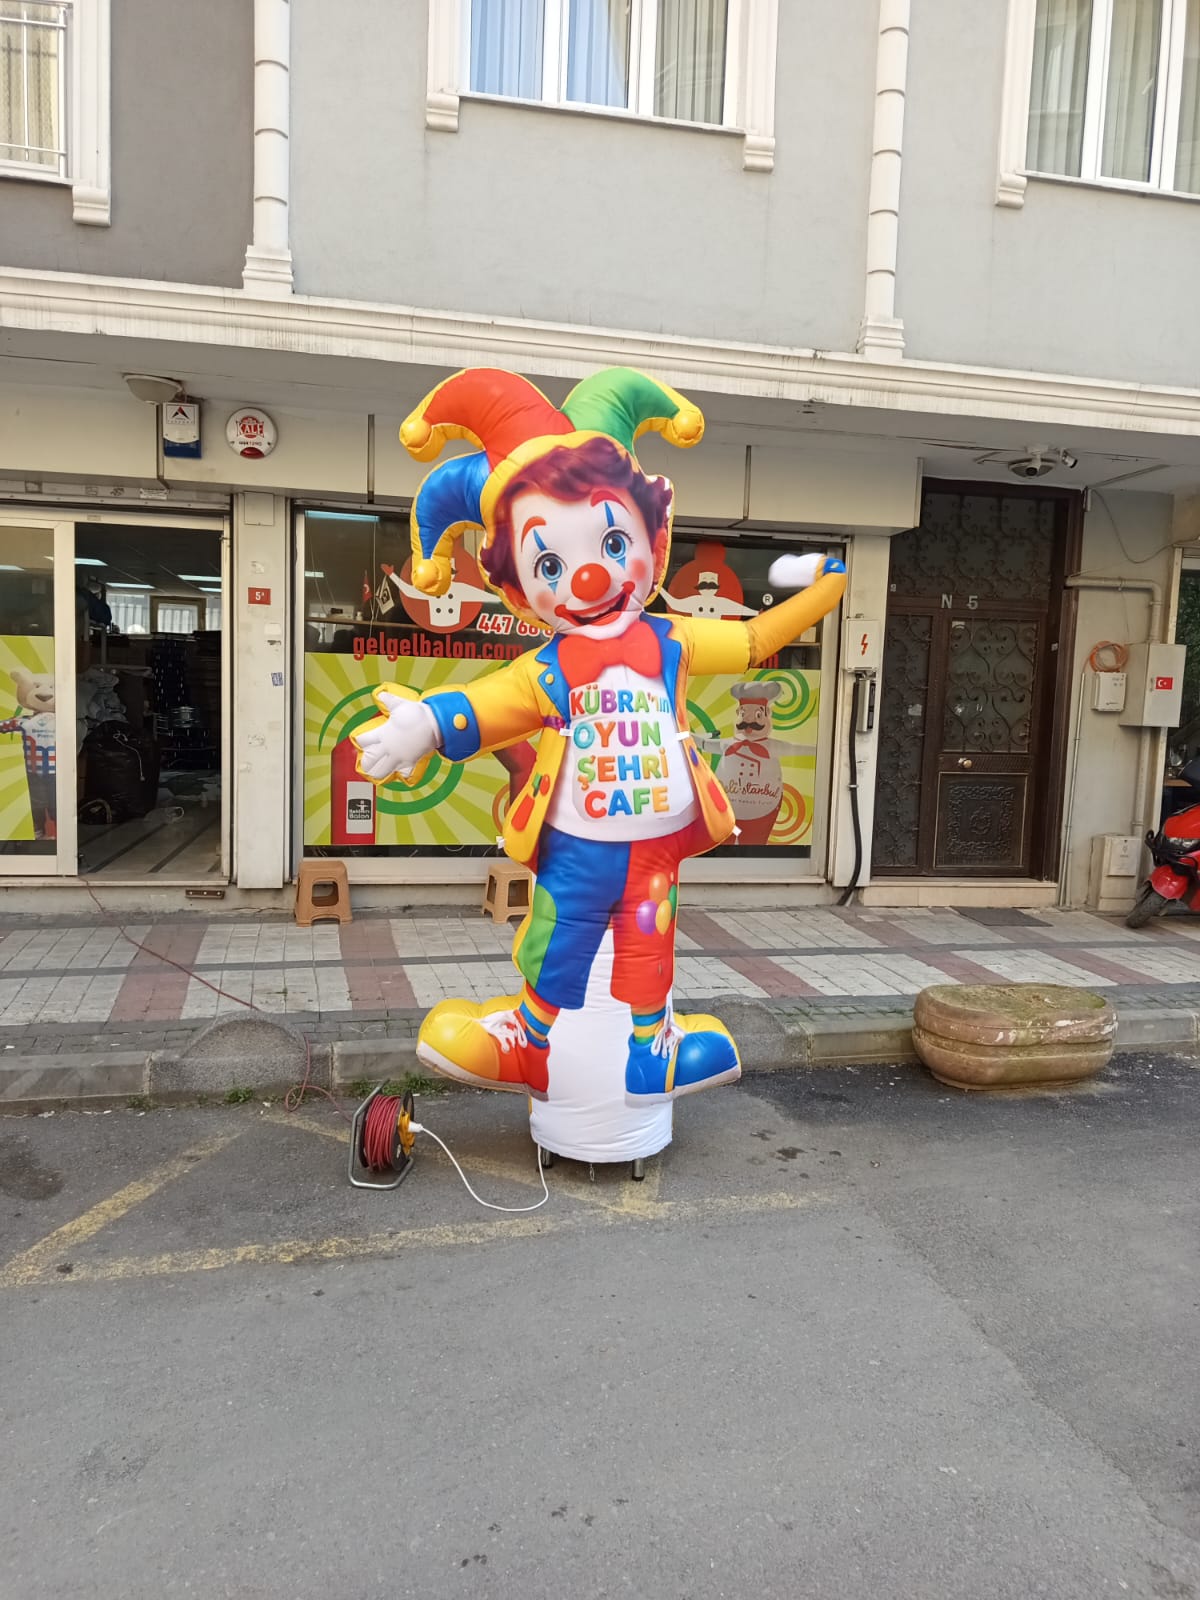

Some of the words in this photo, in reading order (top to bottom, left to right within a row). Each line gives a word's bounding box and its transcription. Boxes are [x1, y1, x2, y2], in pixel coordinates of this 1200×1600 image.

[236, 420, 265, 438] KALE
[966, 595, 979, 610] 5
[477, 613, 513, 635] 447
[353, 631, 524, 662] gelgelbalon.com
[573, 720, 661, 749] OYUN
[584, 786, 670, 819] CAFE
